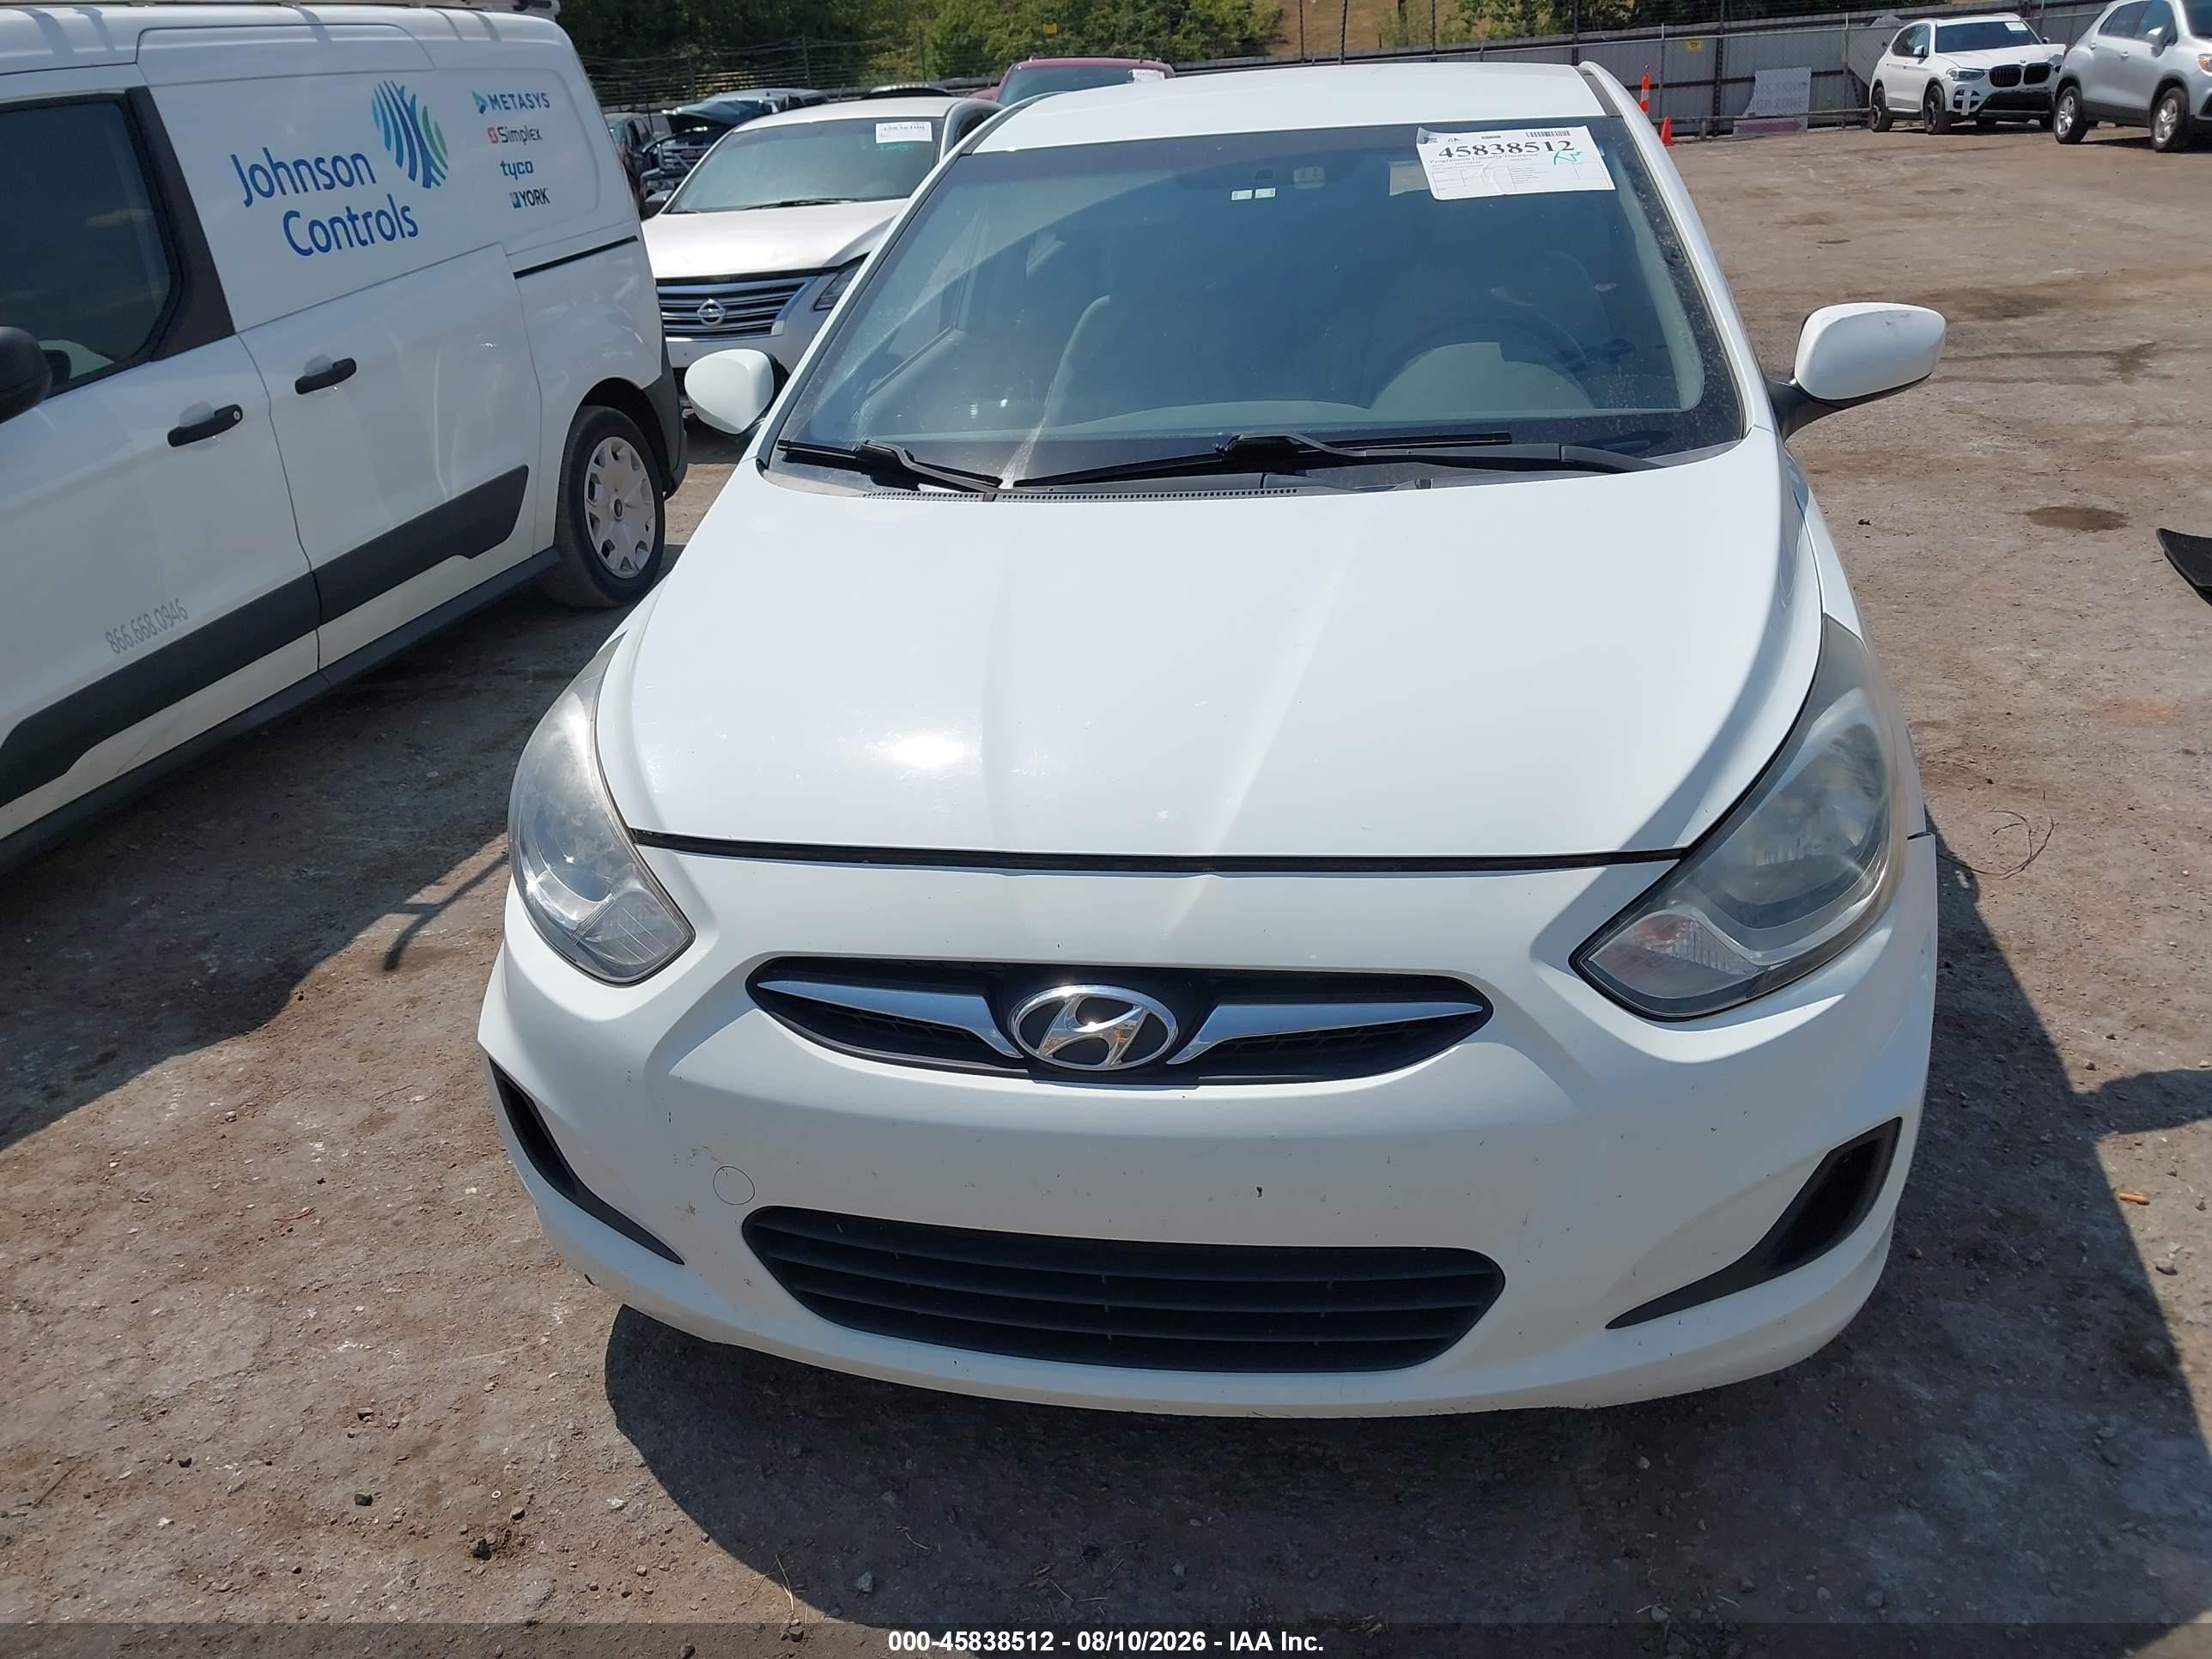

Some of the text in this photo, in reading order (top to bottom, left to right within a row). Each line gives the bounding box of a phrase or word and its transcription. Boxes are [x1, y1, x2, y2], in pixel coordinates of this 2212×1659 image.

[487, 93, 550, 110] METASYS
[497, 125, 543, 145] Simplex
[1437, 139, 1575, 158] 45838512
[230, 147, 376, 208] Johnson
[500, 160, 534, 180] tyco
[519, 188, 550, 207] YORK
[283, 193, 418, 257] Controls
[105, 598, 188, 654] 866.668.0946
